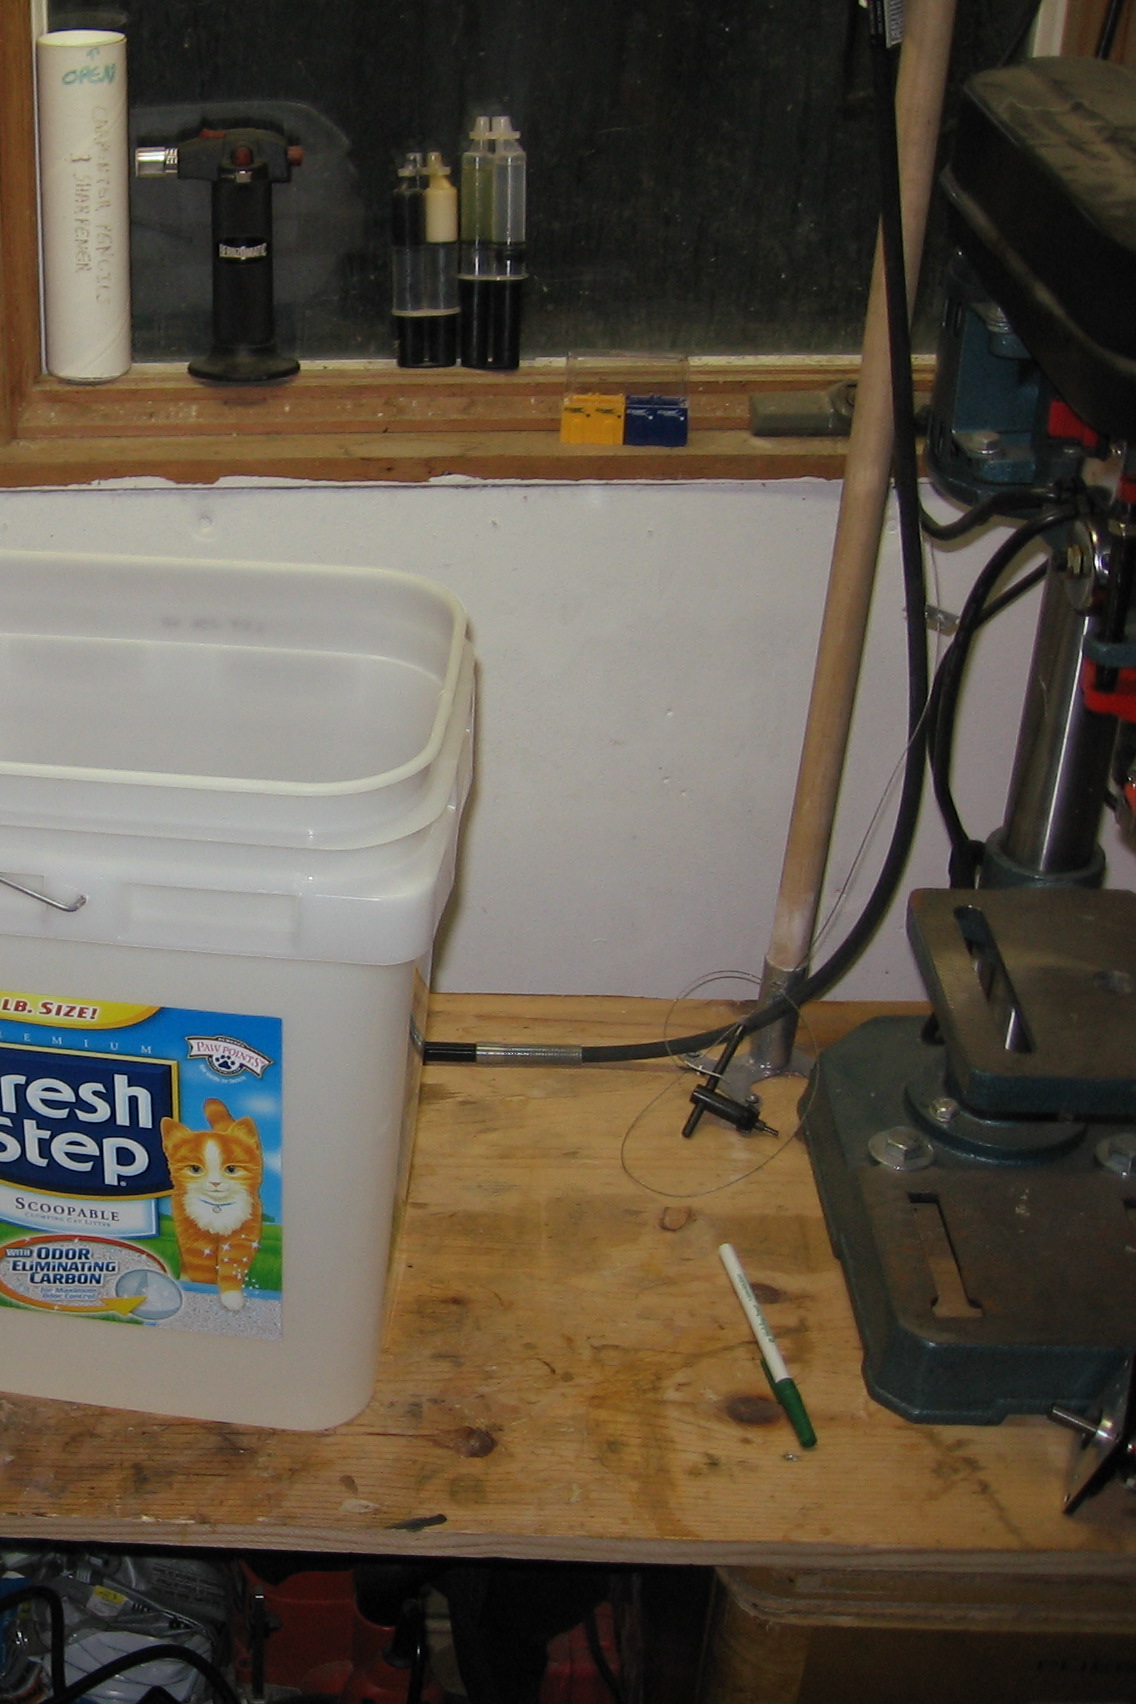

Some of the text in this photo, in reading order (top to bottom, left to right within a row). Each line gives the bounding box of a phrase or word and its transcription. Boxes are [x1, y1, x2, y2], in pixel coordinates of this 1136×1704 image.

[62, 64, 117, 86] OPEN
[2, 998, 33, 1013] LB.
[39, 1001, 99, 1020] SIZE!
[197, 1041, 221, 1053] PAW
[222, 1047, 262, 1068] POINTS
[15, 1196, 121, 1223] SCOOPABLE
[36, 1246, 90, 1261] ODOR
[29, 1272, 102, 1285] CARBON
